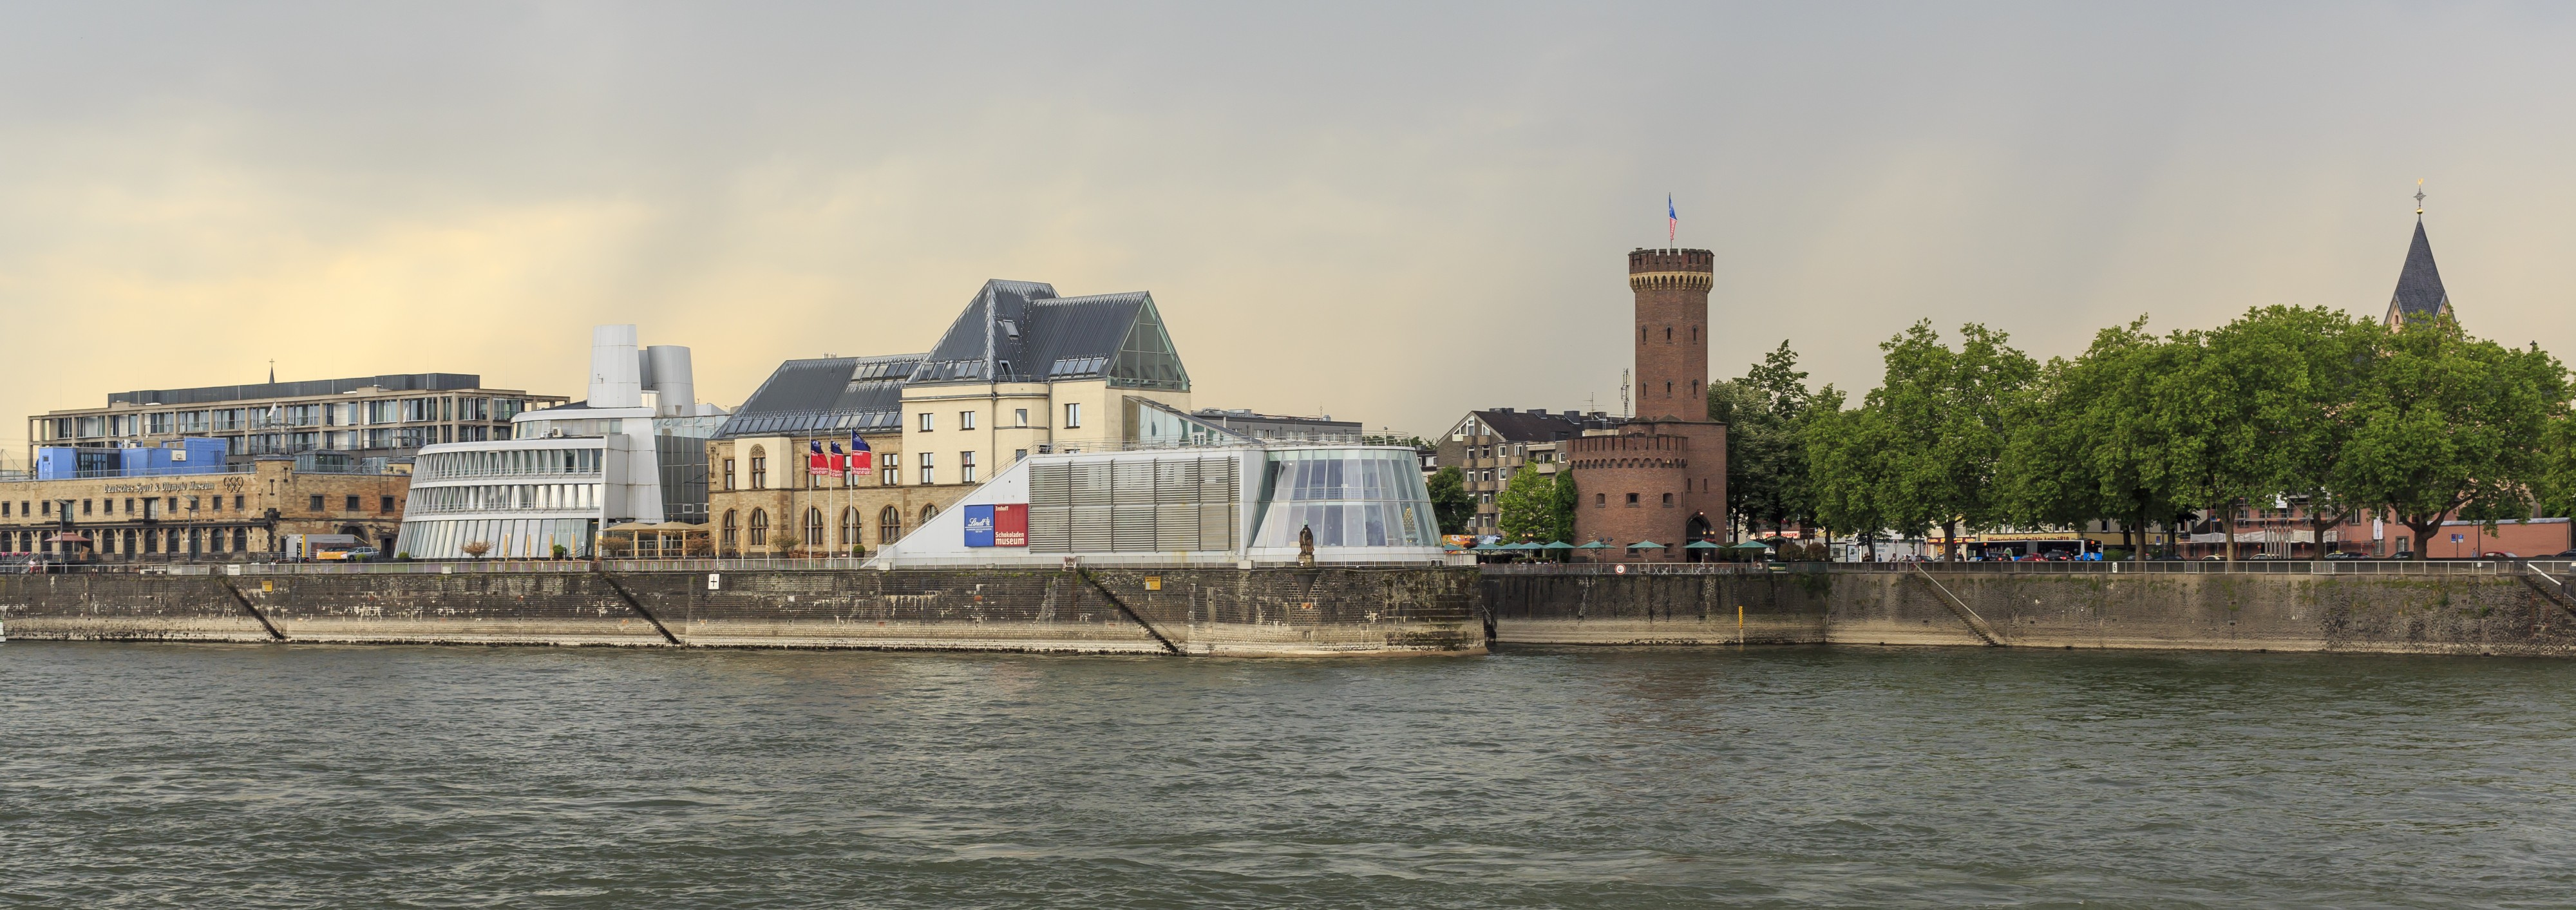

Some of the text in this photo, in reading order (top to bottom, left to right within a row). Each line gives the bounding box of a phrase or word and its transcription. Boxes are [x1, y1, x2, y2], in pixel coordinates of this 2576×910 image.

[104, 481, 214, 494] Deutsches Sport & Olympia Museum
[967, 517, 986, 526] Lindt
